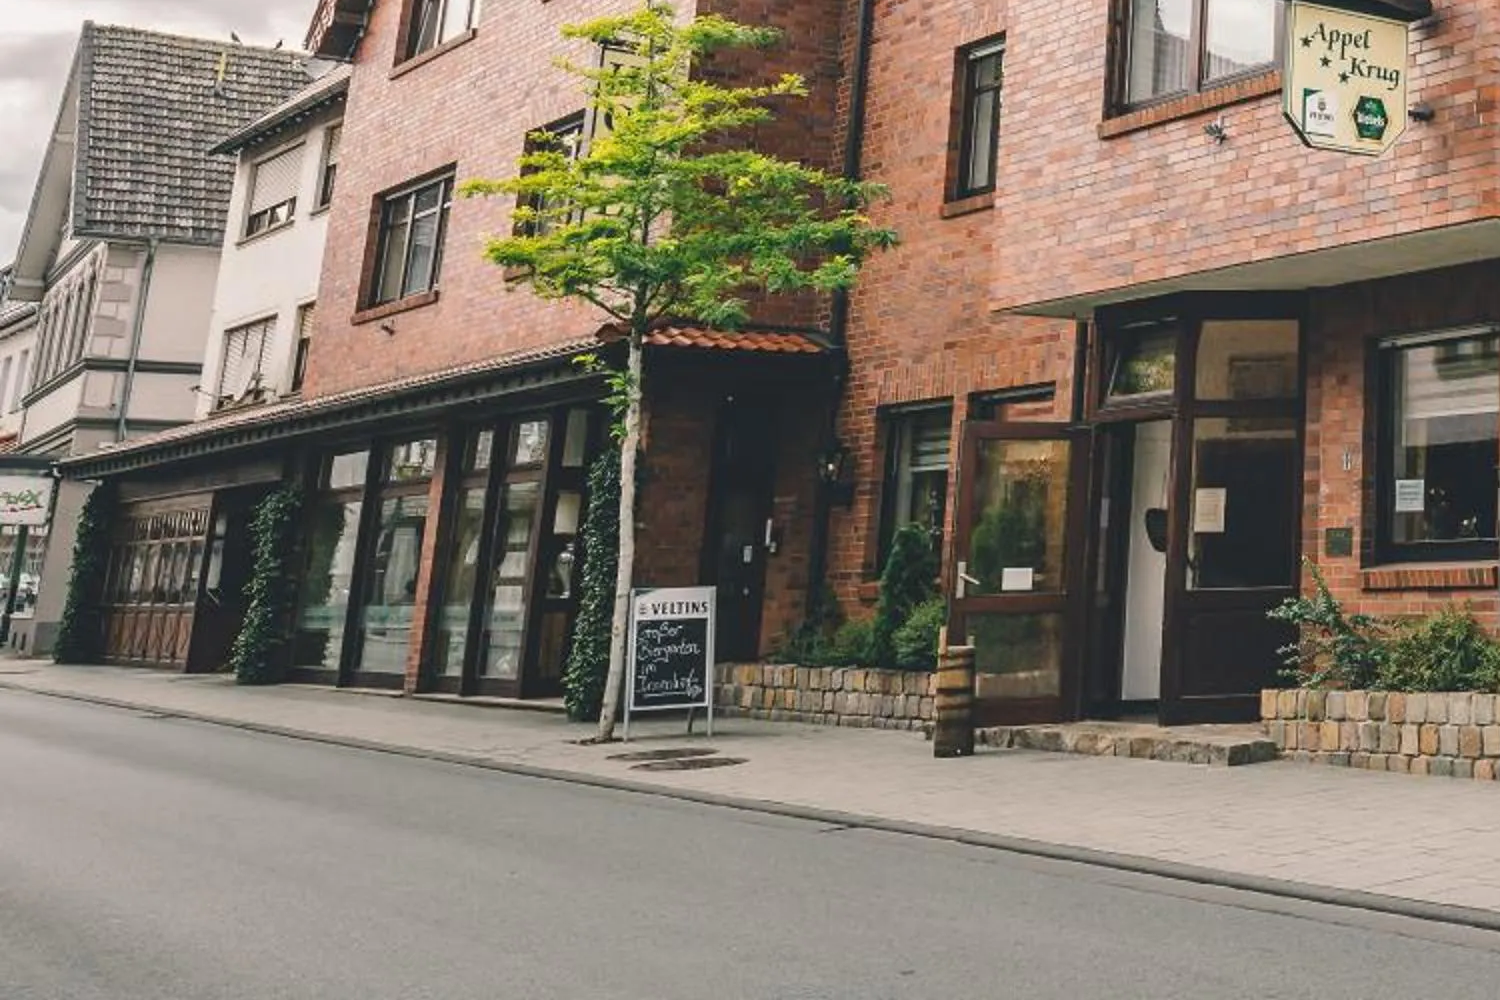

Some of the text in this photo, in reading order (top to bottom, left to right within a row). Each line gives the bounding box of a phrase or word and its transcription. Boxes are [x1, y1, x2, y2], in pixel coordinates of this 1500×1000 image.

[1311, 22, 1372, 61] Appel
[1350, 55, 1401, 91] Krug
[651, 601, 709, 616] VELTINS
